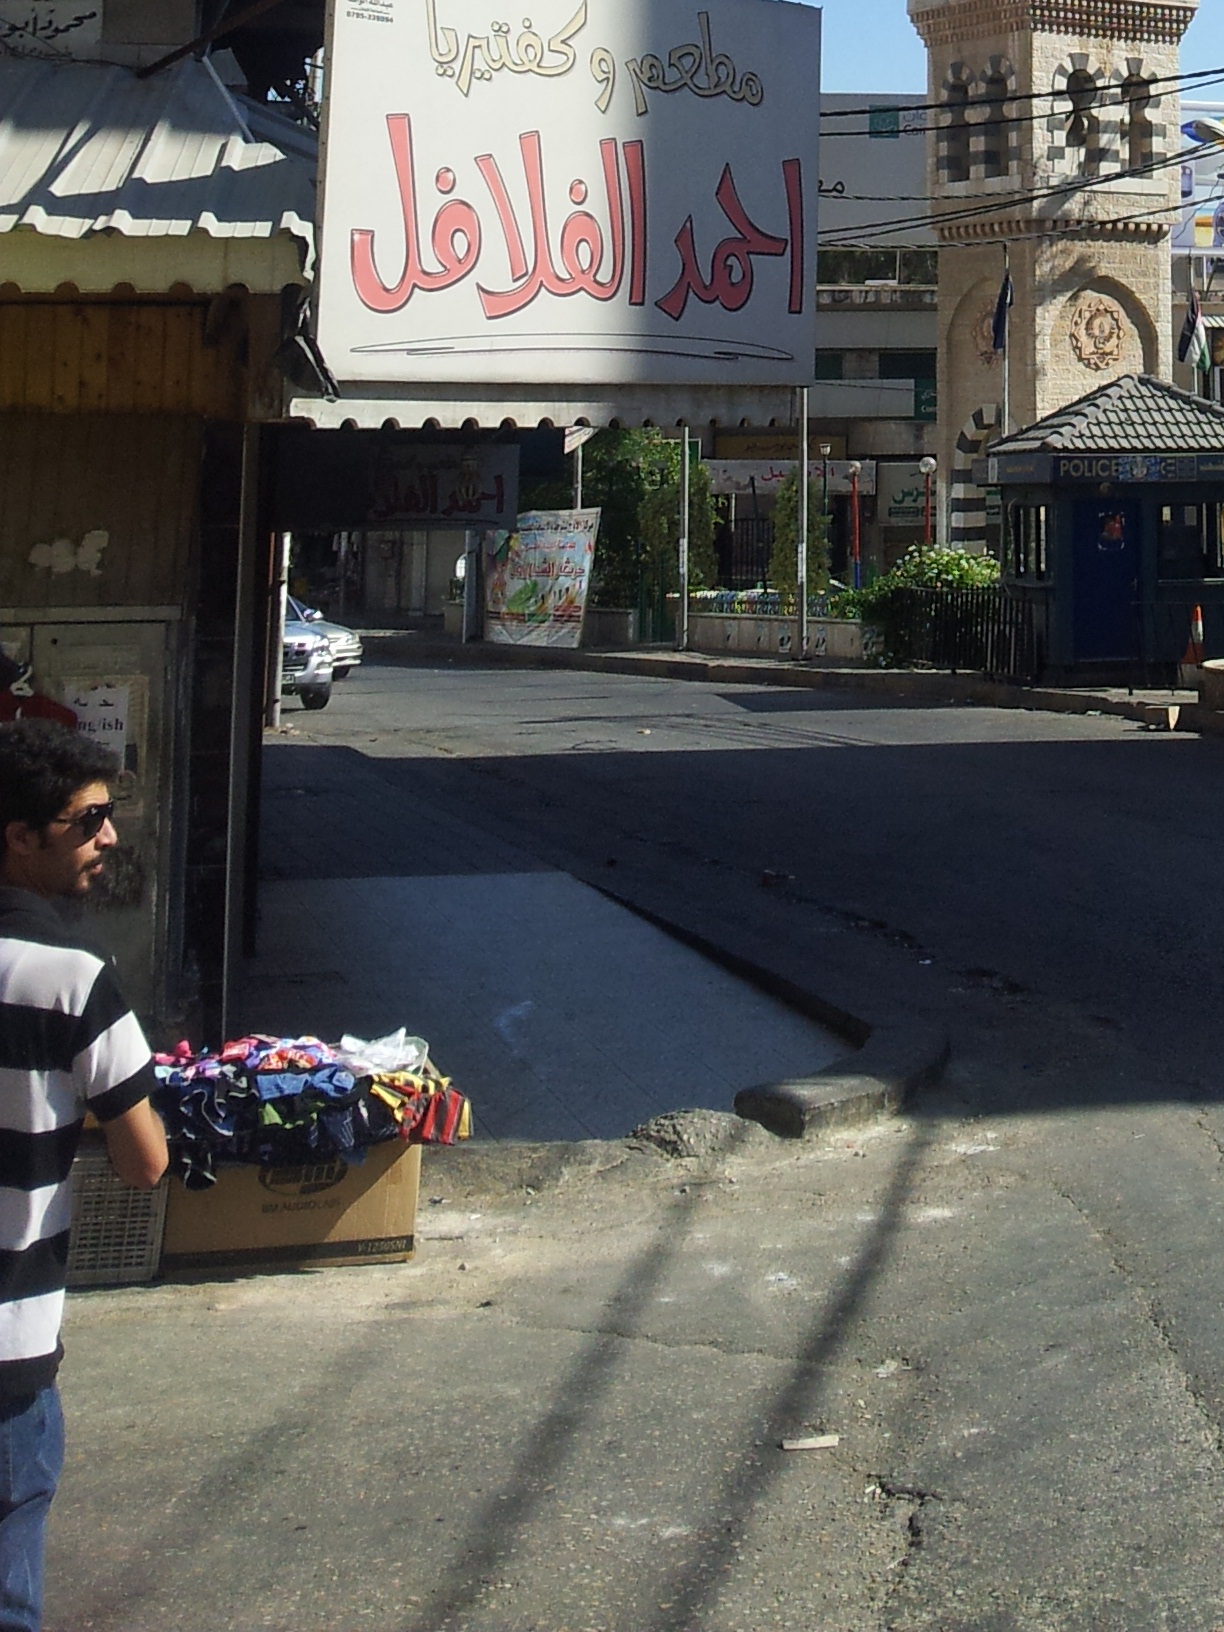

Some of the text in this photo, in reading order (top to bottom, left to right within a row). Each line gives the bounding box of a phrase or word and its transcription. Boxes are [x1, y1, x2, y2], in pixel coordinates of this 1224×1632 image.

[589, 45, 617, 114] و
[625, 11, 764, 116] مطعم
[350, 112, 803, 321] احمد الفلافل
[1060, 459, 1119, 477] POLICE
